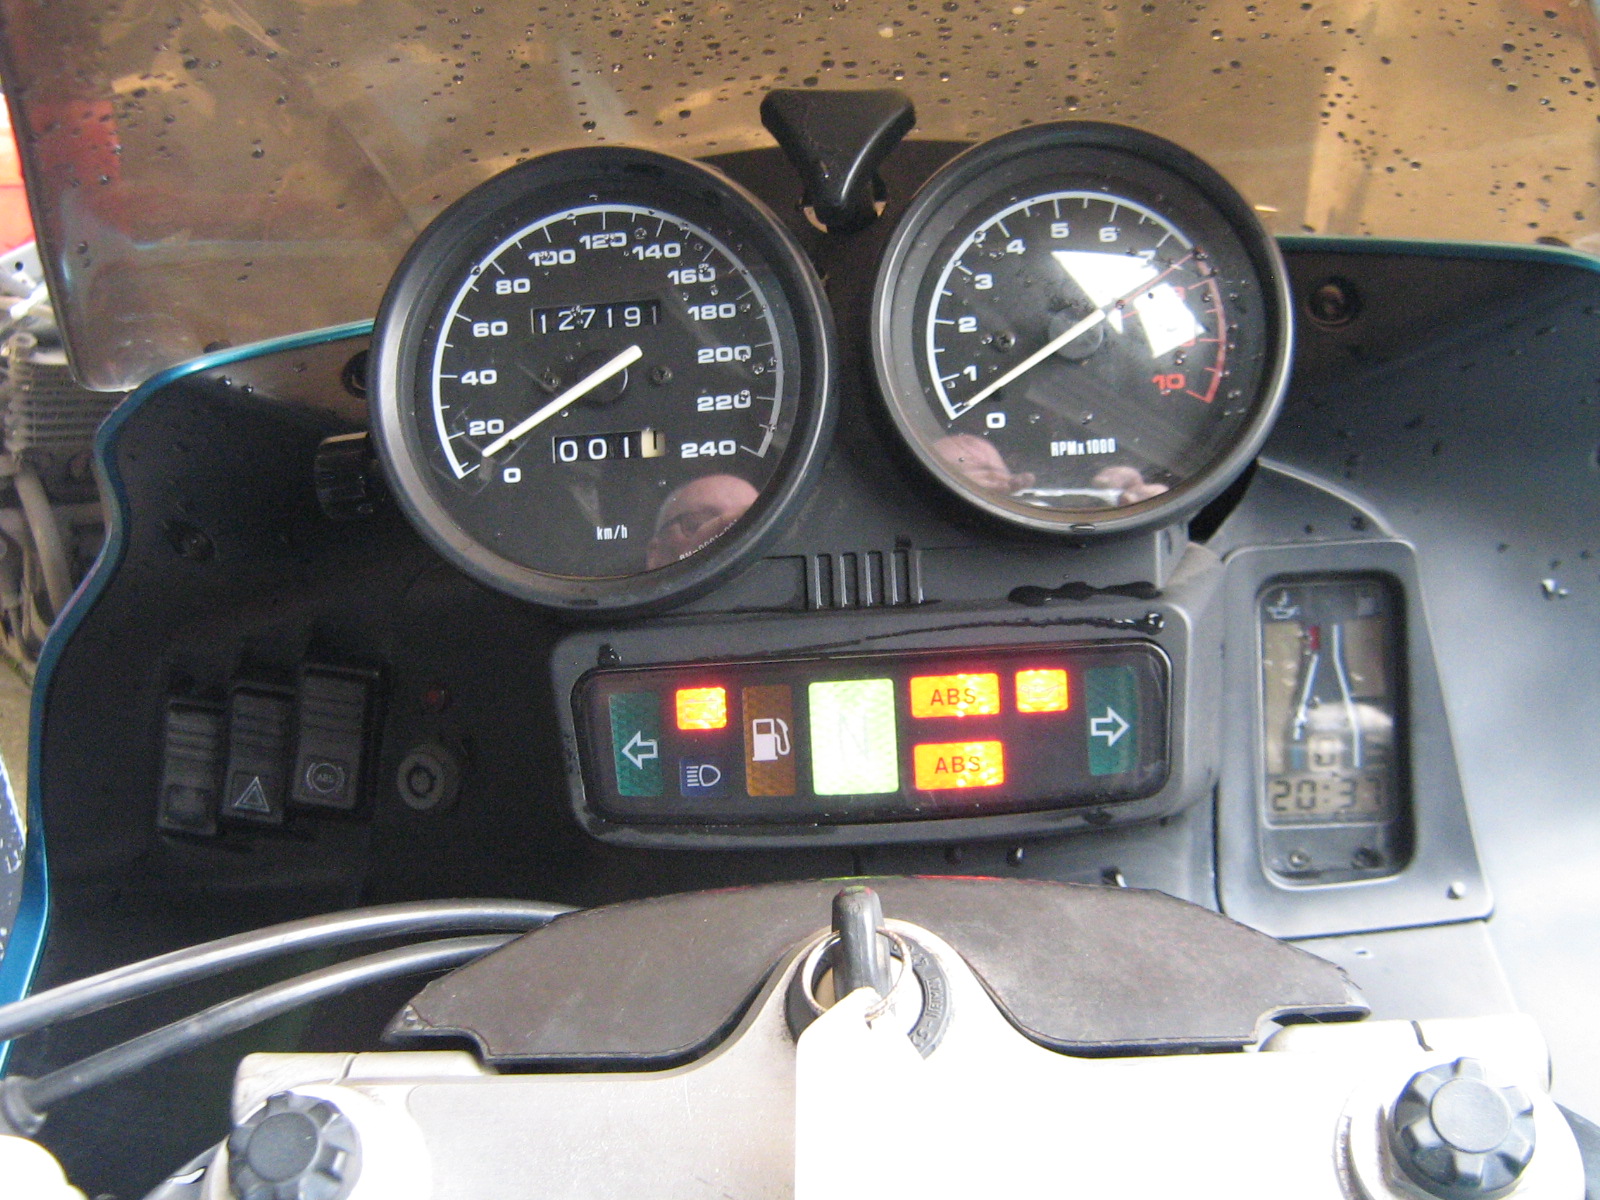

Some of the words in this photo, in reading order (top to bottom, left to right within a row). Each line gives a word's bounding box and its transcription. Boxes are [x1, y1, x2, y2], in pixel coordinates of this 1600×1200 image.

[1050, 222, 1070, 239] 5
[1099, 226, 1118, 243] 6
[578, 232, 627, 250] 120
[1005, 238, 1026, 255] 4
[528, 248, 576, 267] 100
[631, 242, 681, 261] 140
[666, 267, 716, 286] 160
[974, 273, 994, 290] 3
[495, 278, 531, 295] 80
[687, 303, 737, 322] 180
[472, 320, 508, 338] 60
[957, 316, 978, 333] 2
[697, 345, 752, 364] 200
[461, 369, 498, 386] 40
[962, 365, 977, 382] 1
[1151, 373, 1186, 390] 10
[696, 392, 752, 412] 220
[469, 418, 505, 436] 20
[985, 411, 1006, 429] 0
[680, 439, 737, 459] 240
[503, 467, 522, 484] 0
[596, 524, 629, 541] km/h
[930, 688, 977, 706] ABS
[934, 755, 982, 774] ABS
